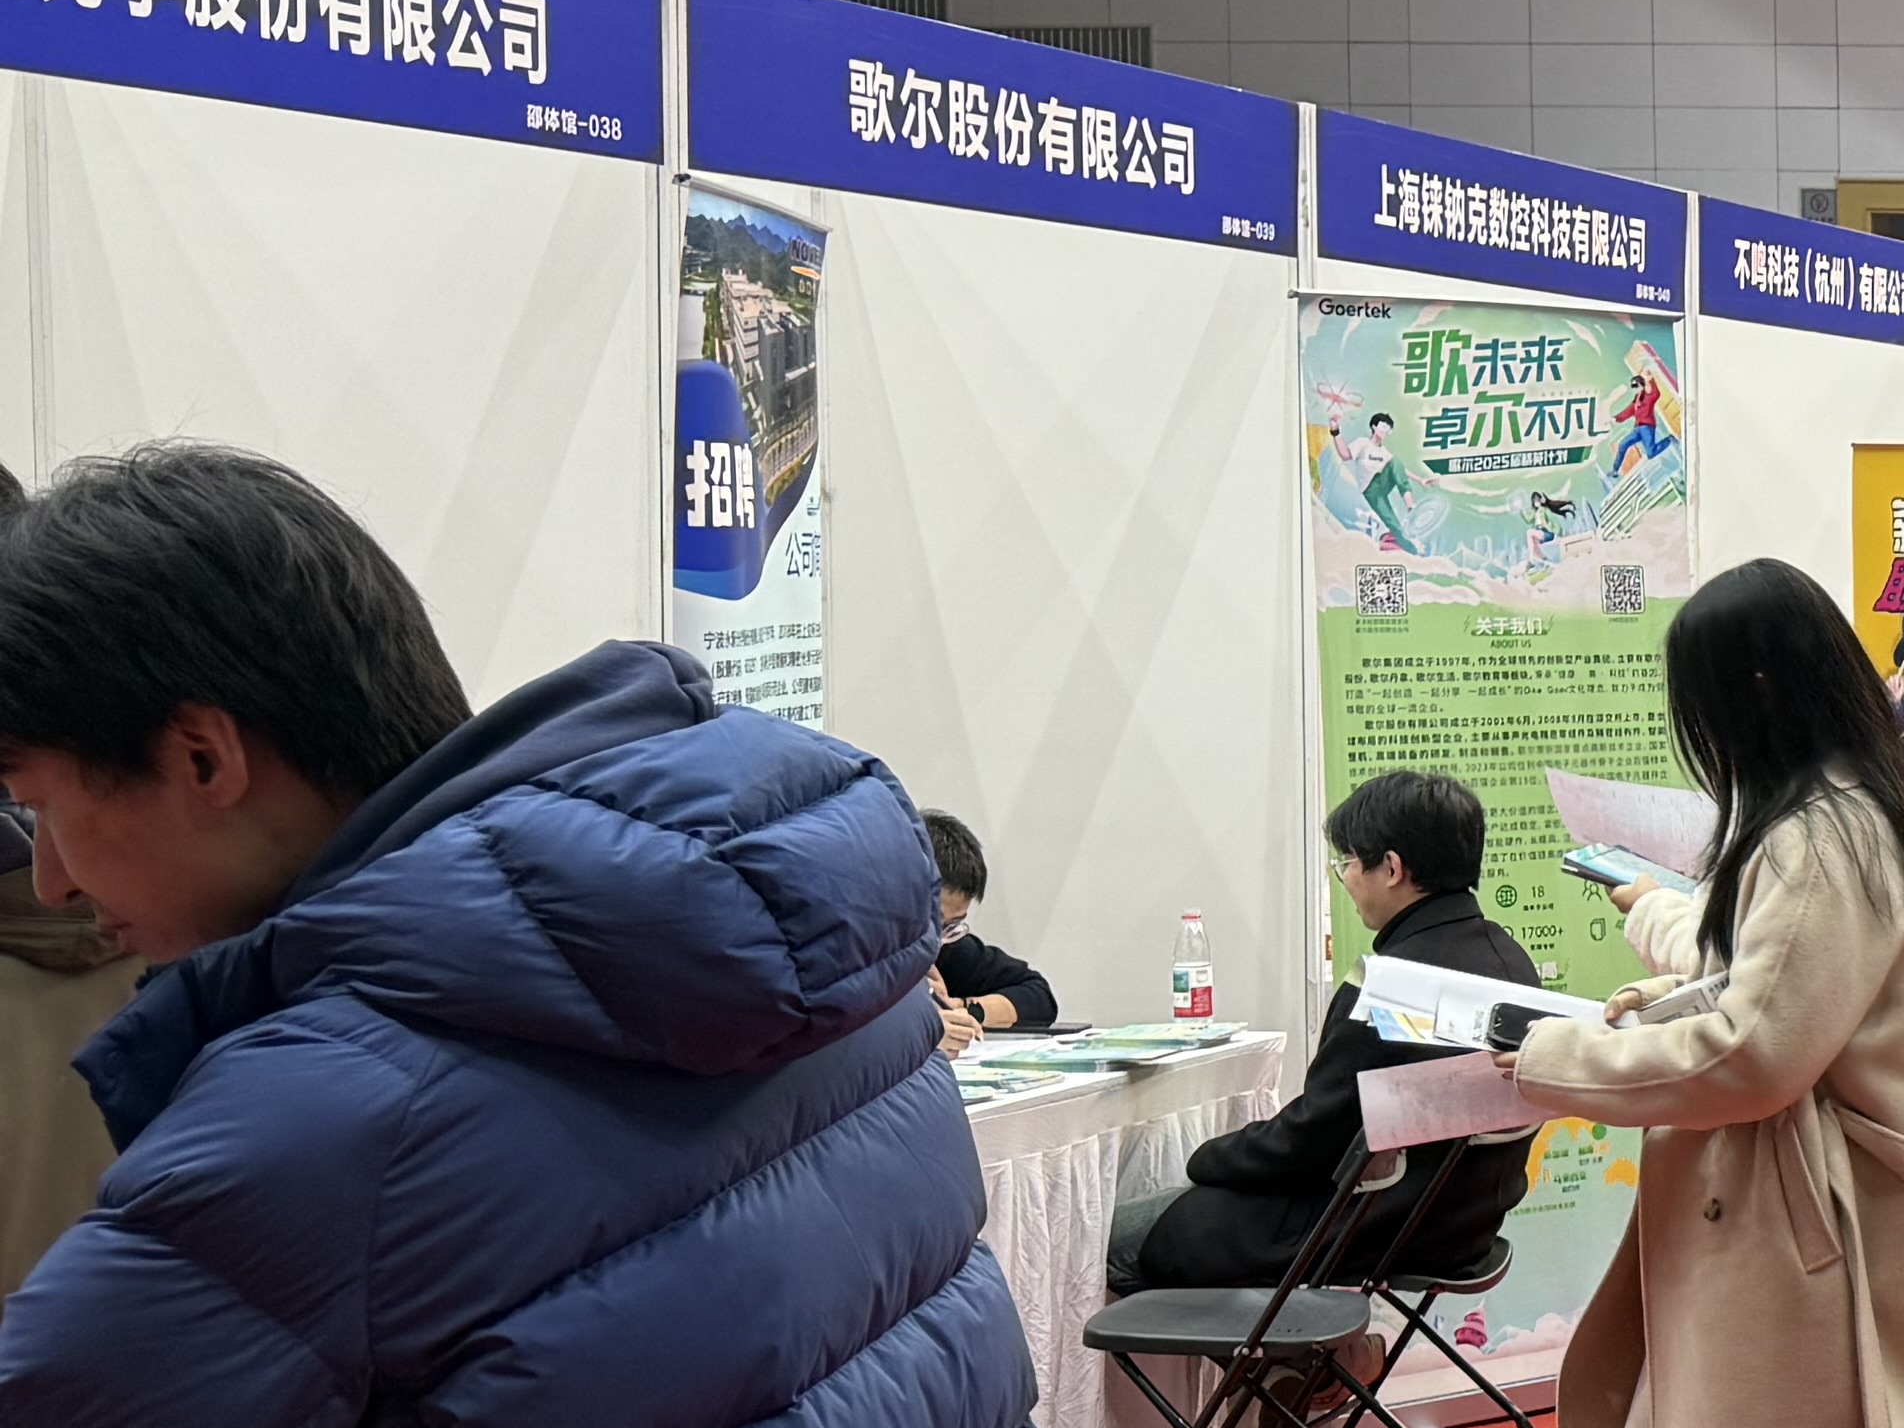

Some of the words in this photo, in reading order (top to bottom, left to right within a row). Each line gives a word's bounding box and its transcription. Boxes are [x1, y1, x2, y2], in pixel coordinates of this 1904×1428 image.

[847, 58, 1196, 196] 歌尔股份有限公司
[1374, 164, 1646, 273] 上海铼钠克数控科技有限公司
[1318, 298, 1392, 320] Goertek
[1392, 329, 1571, 398] 歌未来
[1418, 391, 1613, 450] 卓尔不凡
[687, 439, 756, 529] 招聘
[1475, 616, 1543, 636] 关于我们
[1490, 639, 1518, 650] ABOUT
[1520, 638, 1532, 649] US
[1531, 885, 1545, 899] 18
[1521, 925, 1564, 940] 17000+
